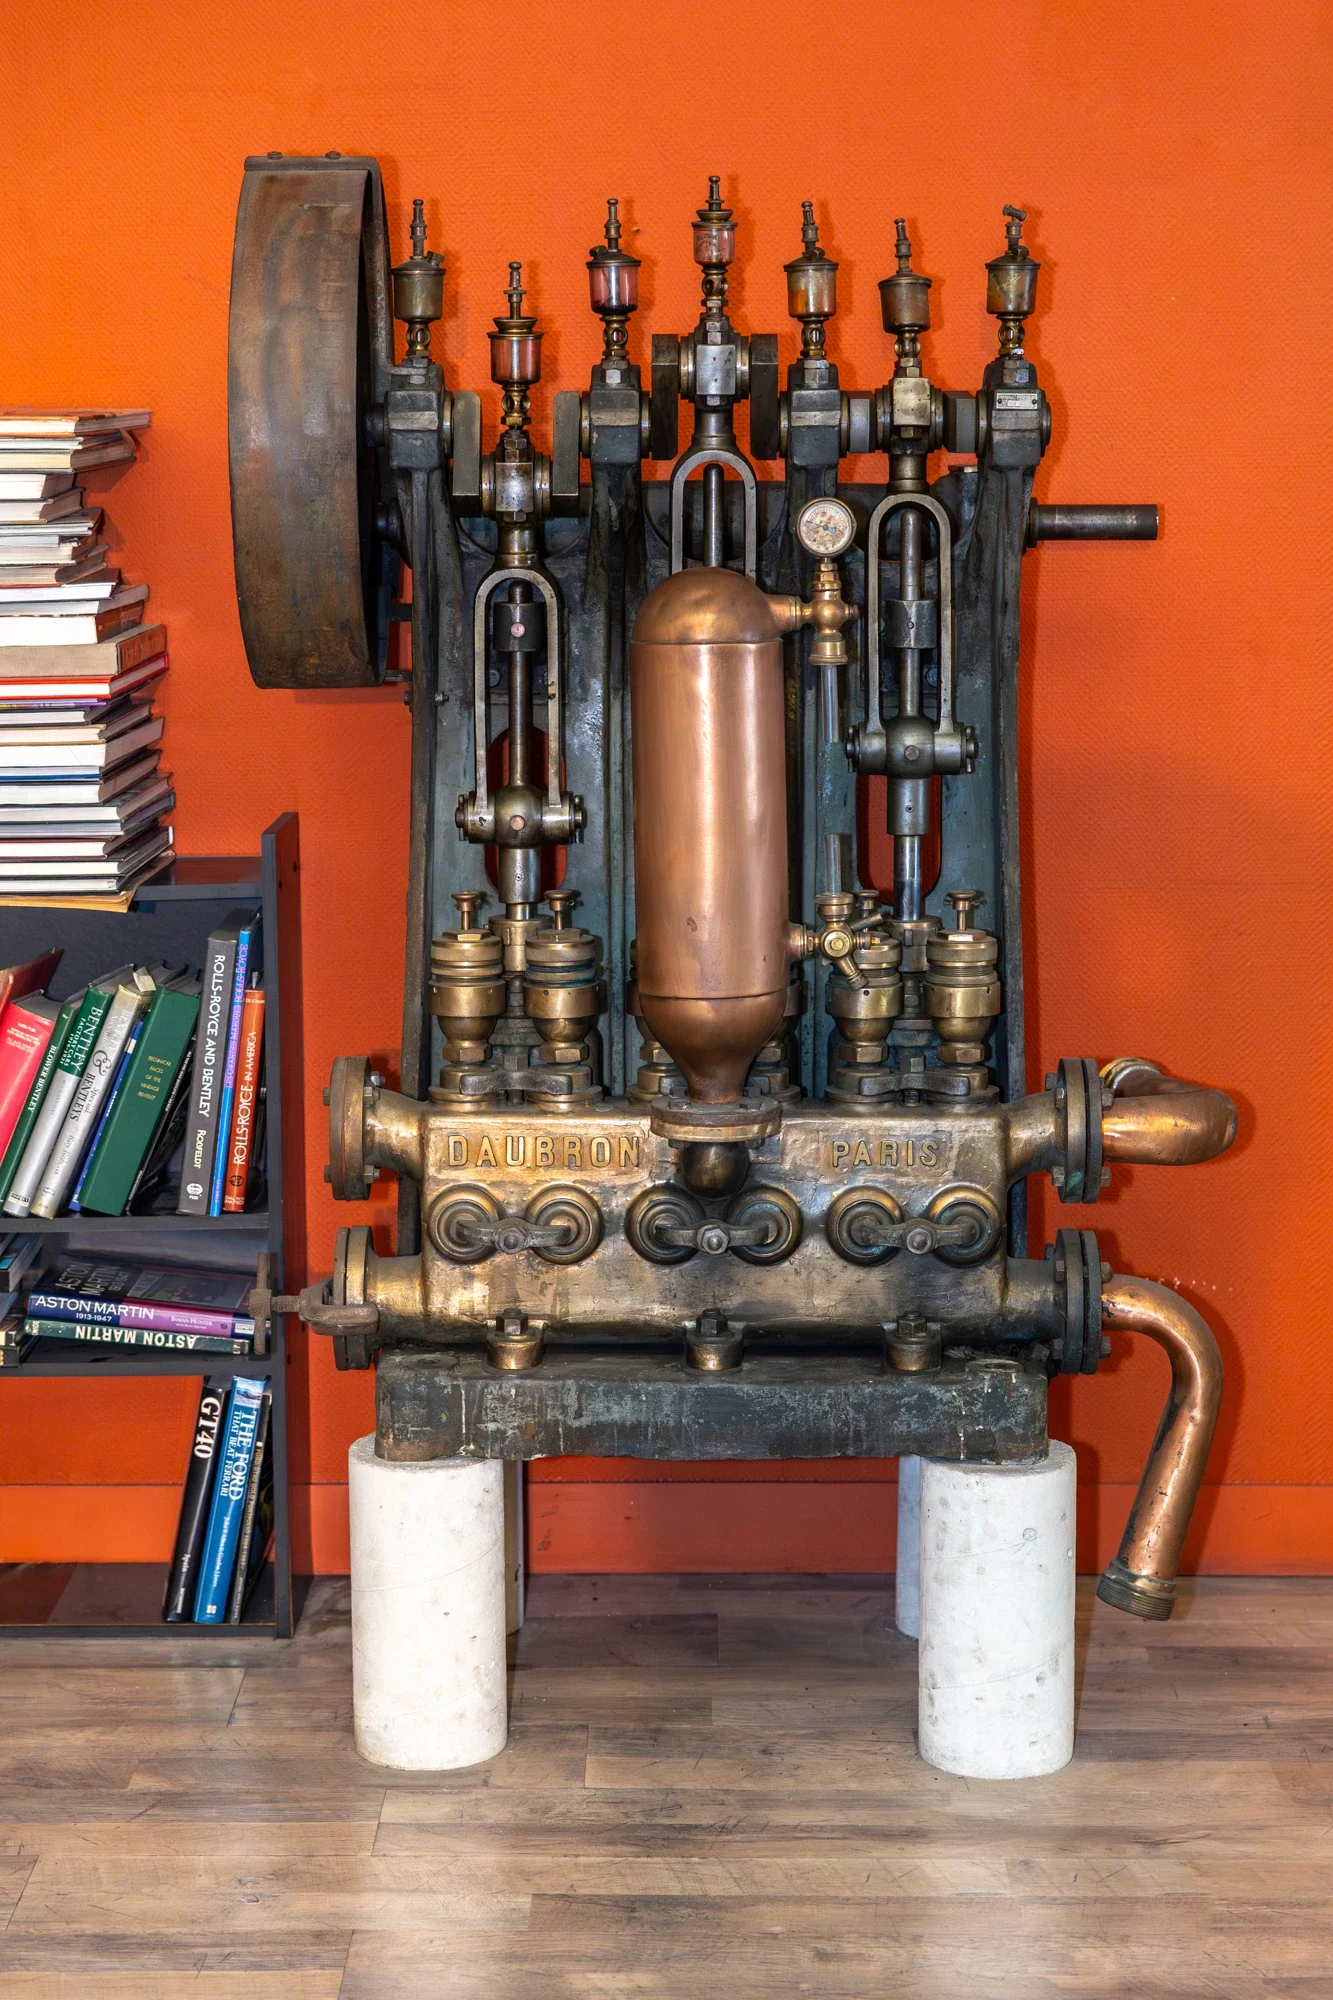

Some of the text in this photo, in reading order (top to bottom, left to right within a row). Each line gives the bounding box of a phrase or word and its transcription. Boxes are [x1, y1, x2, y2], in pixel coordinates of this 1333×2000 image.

[234, 943, 248, 1002] ROLLS-ROYCE
[63, 1017, 86, 1066] FACTORY CARS
[70, 1006, 104, 1071] BENTLEY
[199, 954, 226, 1118] ROLLS-ROYCE AND BENTLEY
[40, 1045, 57, 1077] BLOWER
[92, 1050, 111, 1076] &
[28, 1077, 45, 1113] BENTLEY
[70, 1072, 96, 1121] BENTLEYS
[85, 1087, 100, 1113] Special
[234, 1031, 256, 1165] ROLLS-ROYCE IN AMERICA
[446, 1134, 641, 1168] DAUBRON
[830, 1140, 940, 1168] PARIS
[55, 1263, 93, 1290] ASTON
[35, 1296, 155, 1320] ASTON MARTIN
[76, 1312, 112, 1322] 1913-1947
[75, 1325, 199, 1349] ASTON MARTIN
[194, 1396, 221, 1459] GT40
[220, 1411, 242, 1497] THAT BEAT FERRARI
[228, 1410, 257, 1500] THE FORD
[244, 1500, 253, 1533] PORTFOLIO
